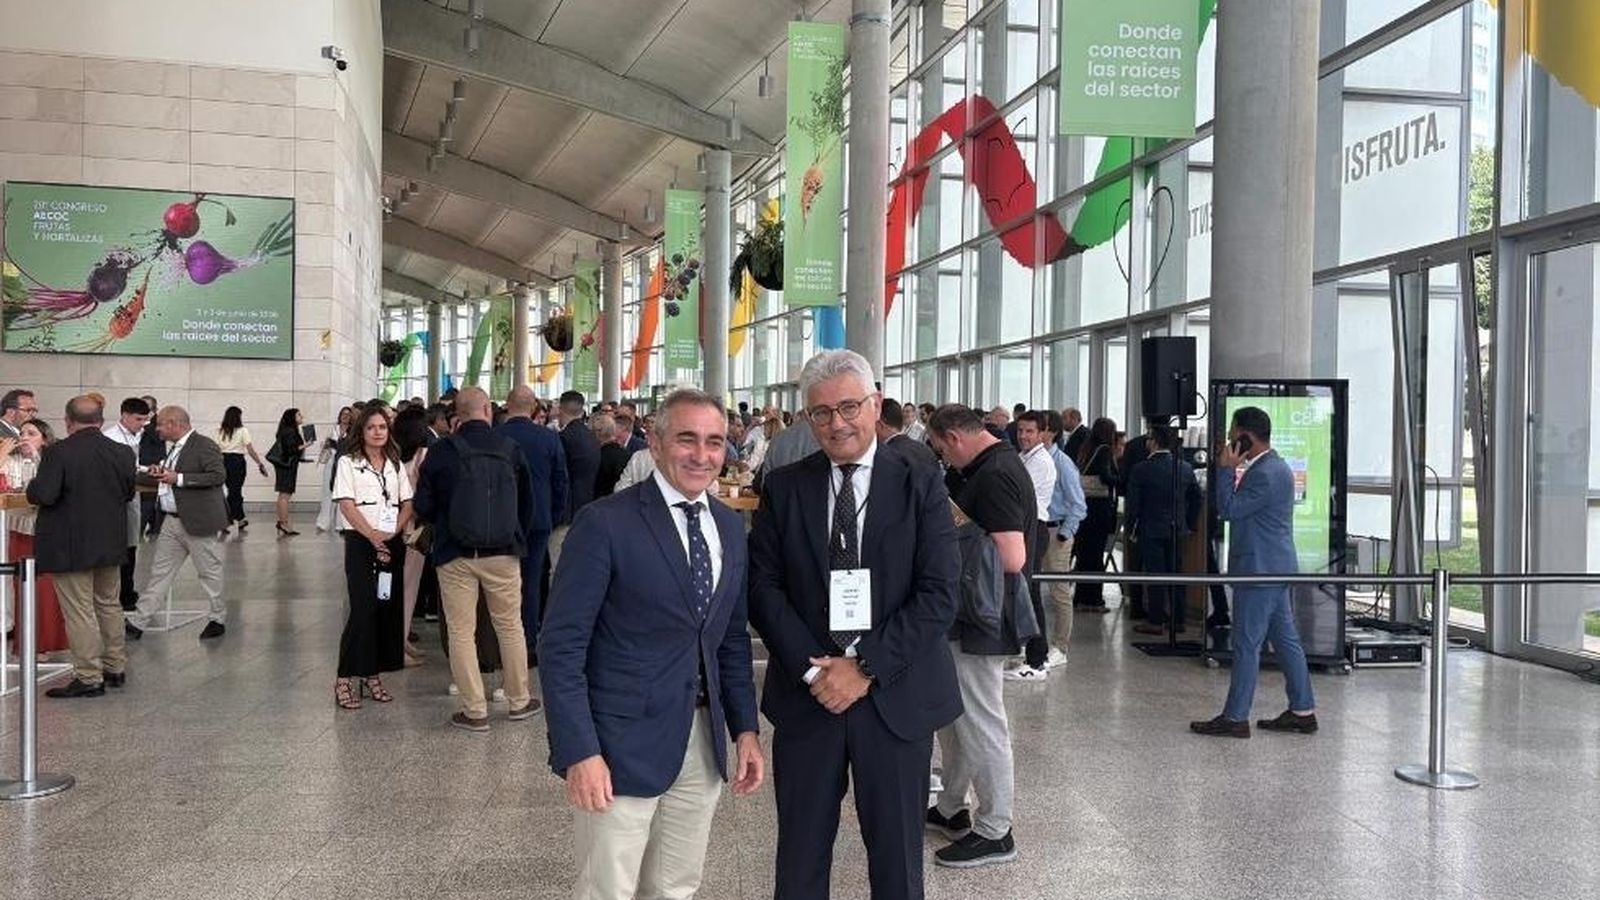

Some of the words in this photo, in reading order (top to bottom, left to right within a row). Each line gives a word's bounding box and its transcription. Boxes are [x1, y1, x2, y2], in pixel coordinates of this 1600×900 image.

[1119, 23, 1182, 40] Donde
[1088, 45, 1182, 60] conectan
[1088, 61, 1117, 78] las
[1085, 80, 1115, 97] del
[1120, 83, 1181, 98] sector
[182, 320, 221, 330] Donde
[223, 321, 278, 332] conectan
[162, 330, 181, 341] las
[221, 332, 241, 343] del
[242, 333, 279, 344] sector
